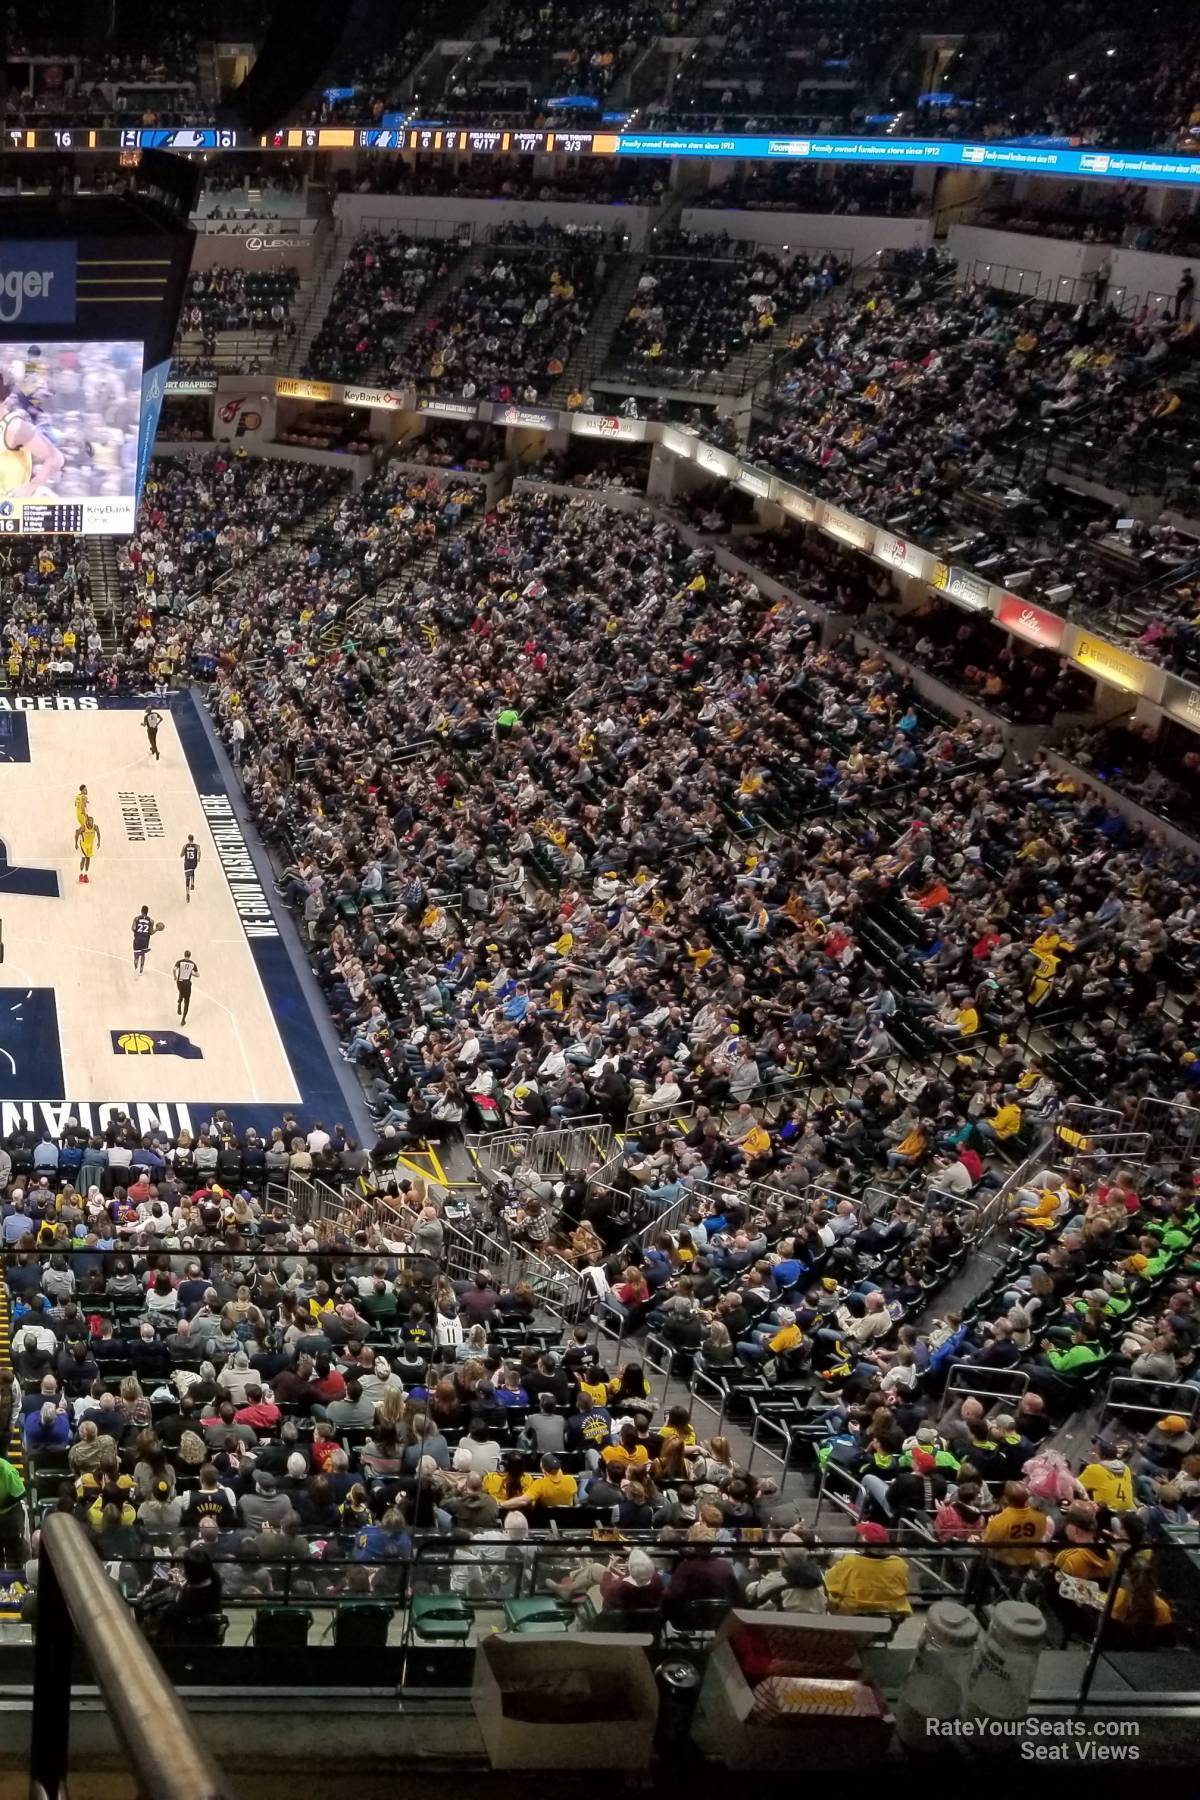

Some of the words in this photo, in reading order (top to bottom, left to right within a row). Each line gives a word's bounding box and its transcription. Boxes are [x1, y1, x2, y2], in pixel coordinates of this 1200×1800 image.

[54, 132, 71, 146] 16
[306, 136, 314, 146] 6
[473, 139, 495, 150] 6/17
[520, 140, 536, 150] 1/7
[622, 140, 640, 150] Family
[564, 141, 581, 152] 3/3
[812, 144, 833, 154] Family
[924, 147, 940, 156] 1912
[263, 240, 310, 248] LEXUS
[277, 381, 298, 394] HOME
[344, 390, 381, 402] KeyBank
[599, 418, 614, 428] the
[601, 427, 618, 437] fan
[86, 505, 131, 514] KeyBank
[1018, 609, 1041, 635] Lilly
[118, 792, 138, 804] LIFE
[200, 794, 234, 816] HERE
[138, 794, 166, 838] FIELDHOUSE
[122, 808, 146, 841] BANKERS
[208, 818, 258, 880] BASKETBALL
[186, 852, 194, 860] 13
[230, 883, 272, 916] GROW
[137, 924, 149, 932] 22
[242, 919, 280, 938] WE
[446, 1328, 456, 1343] 11
[1115, 1484, 1126, 1500] 4
[1010, 1522, 1036, 1538] 29
